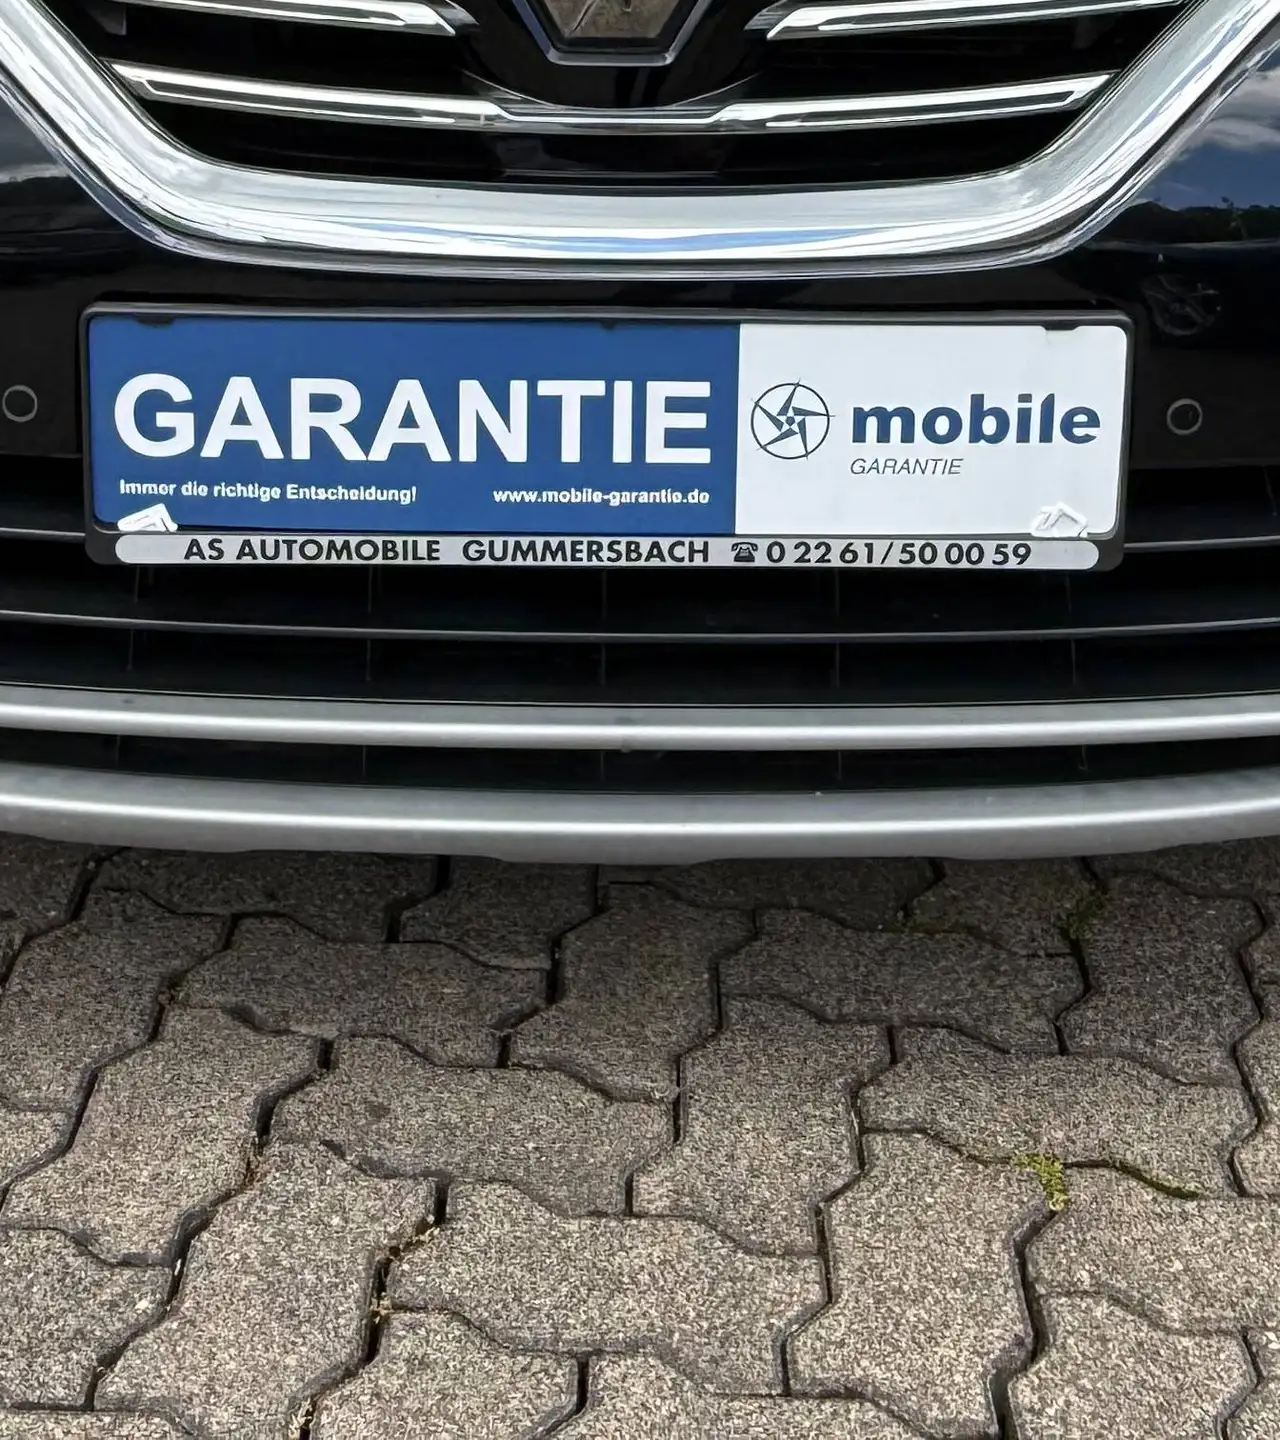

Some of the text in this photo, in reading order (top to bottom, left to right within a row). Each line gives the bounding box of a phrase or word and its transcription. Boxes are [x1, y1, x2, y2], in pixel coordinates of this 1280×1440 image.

[114, 373, 711, 464] GARANTIE
[852, 393, 1101, 445] mobile
[850, 458, 964, 476] GARANTIE
[120, 479, 417, 505] Immer die richtige Entscheidung!
[492, 488, 710, 507] www.mobile-garantie.de
[183, 538, 224, 561] AS
[235, 539, 441, 562] AUTOMOBILE
[462, 539, 709, 563] GUMMERSBACH
